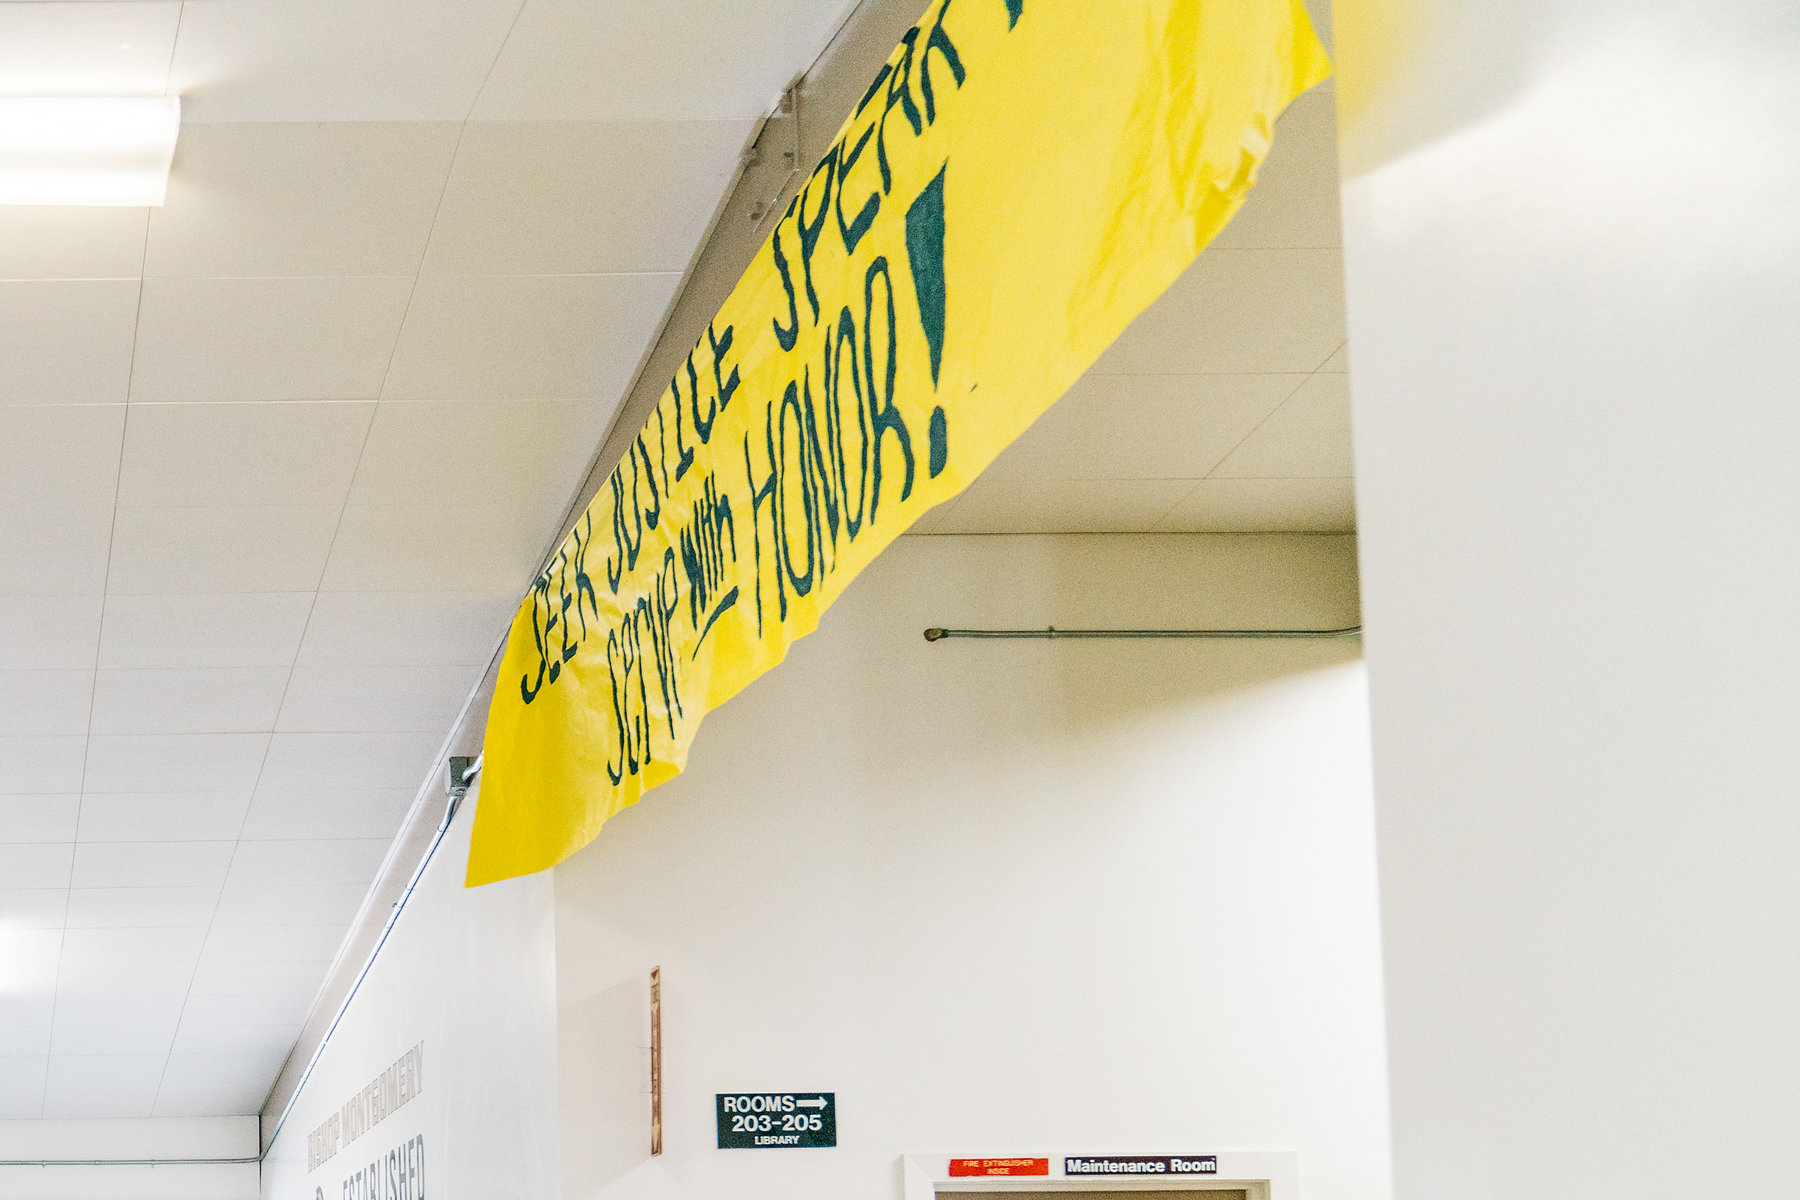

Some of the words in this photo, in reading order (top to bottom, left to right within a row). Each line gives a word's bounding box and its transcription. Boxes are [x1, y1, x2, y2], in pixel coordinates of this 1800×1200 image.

[341, 1039, 424, 1149] MONTGOMERY
[723, 1095, 796, 1113] ROOMS
[731, 1114, 823, 1132] 203-205
[754, 1135, 800, 1145] LIBRARY
[963, 1160, 980, 1168] FIRE
[1066, 1159, 1166, 1174] Maintenance
[1170, 1158, 1216, 1172] Room
